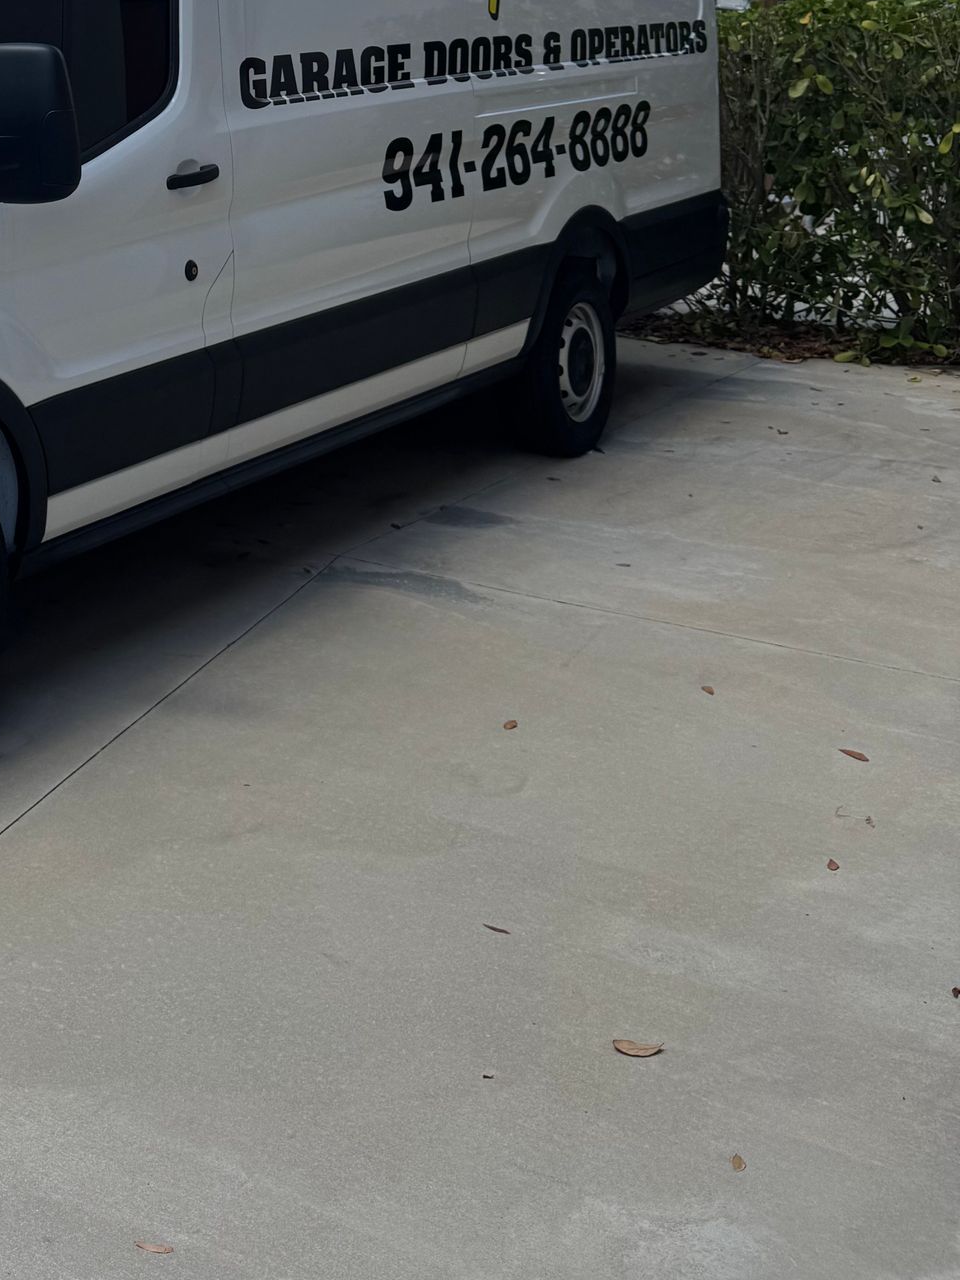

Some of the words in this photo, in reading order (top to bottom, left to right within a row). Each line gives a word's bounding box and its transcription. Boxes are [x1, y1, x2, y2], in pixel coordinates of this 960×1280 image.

[240, 43, 415, 109] GARAGE
[423, 33, 534, 85] DOORS
[542, 32, 565, 70] &
[570, 20, 707, 67] OPERATORS
[382, 100, 652, 212] 941-264-8888
